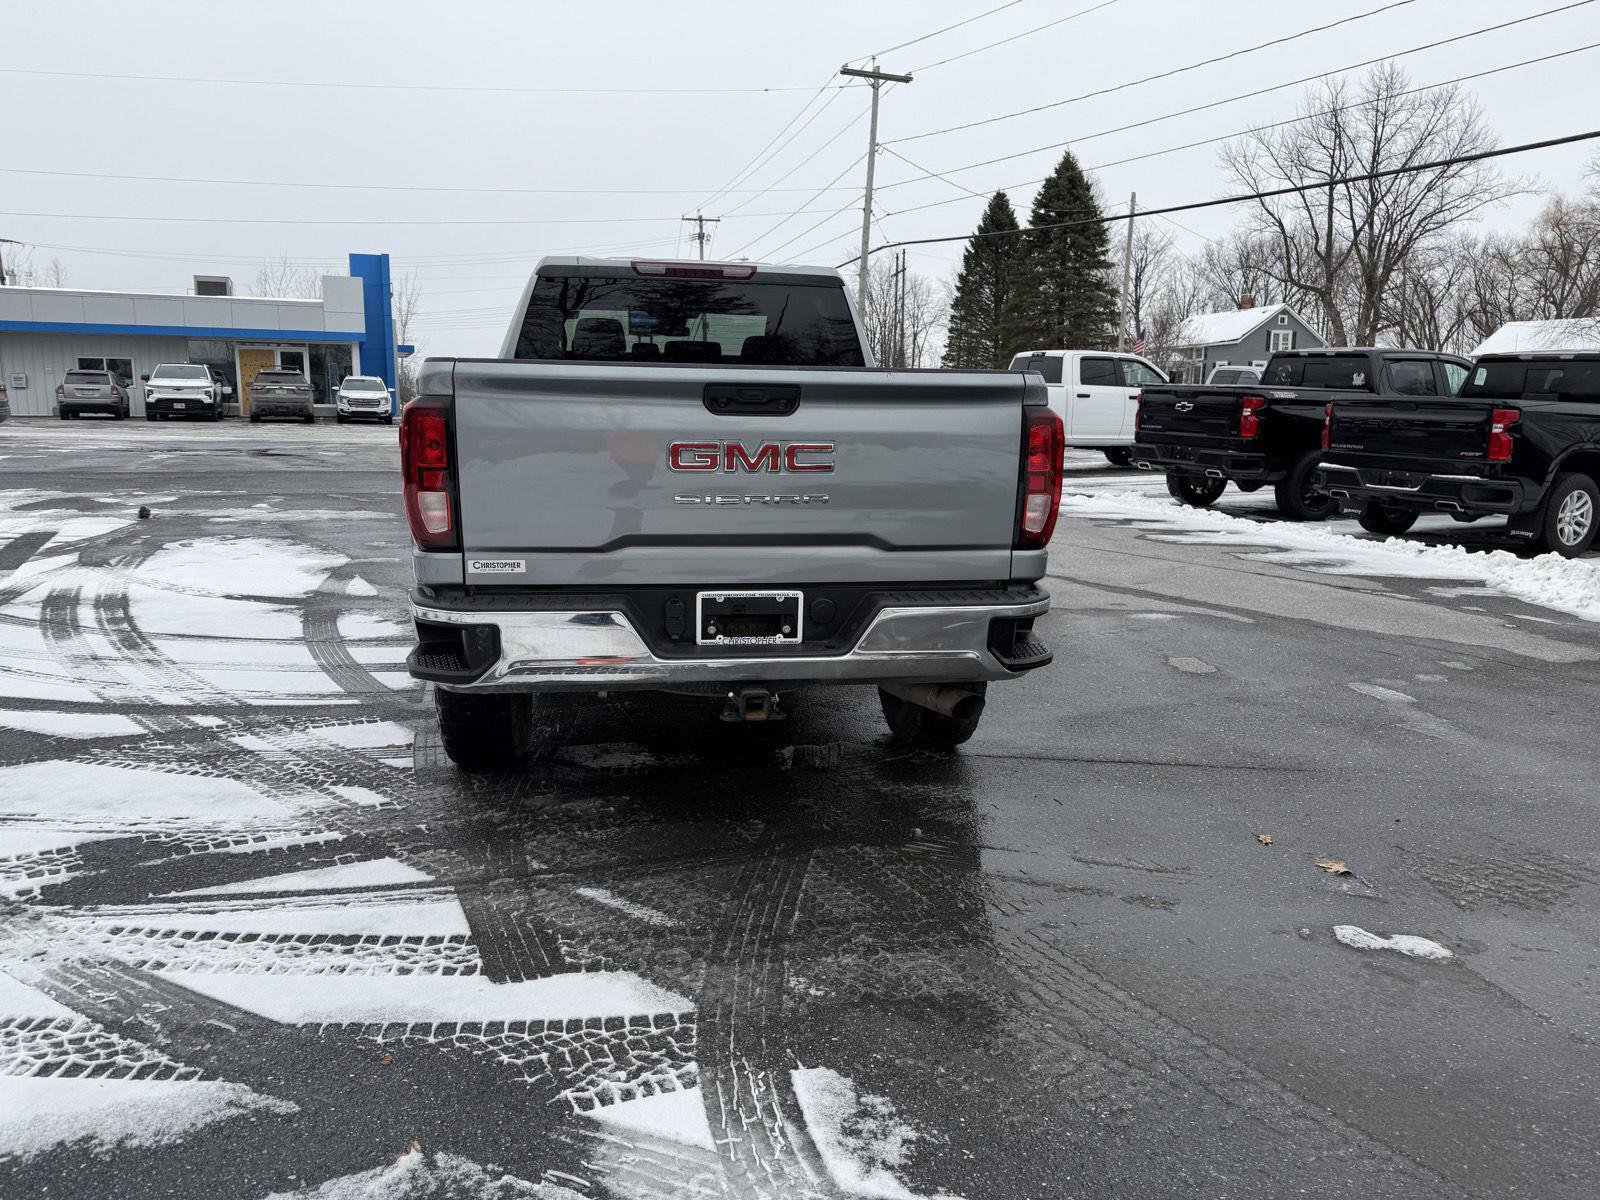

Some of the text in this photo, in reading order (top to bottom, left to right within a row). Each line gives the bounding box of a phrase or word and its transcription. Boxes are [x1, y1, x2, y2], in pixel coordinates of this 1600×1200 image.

[667, 439, 836, 475] GMC
[673, 494, 830, 505] SIERRA
[472, 561, 521, 570] CHRISTOPHER
[722, 636, 777, 645] CHRISTOPHER
